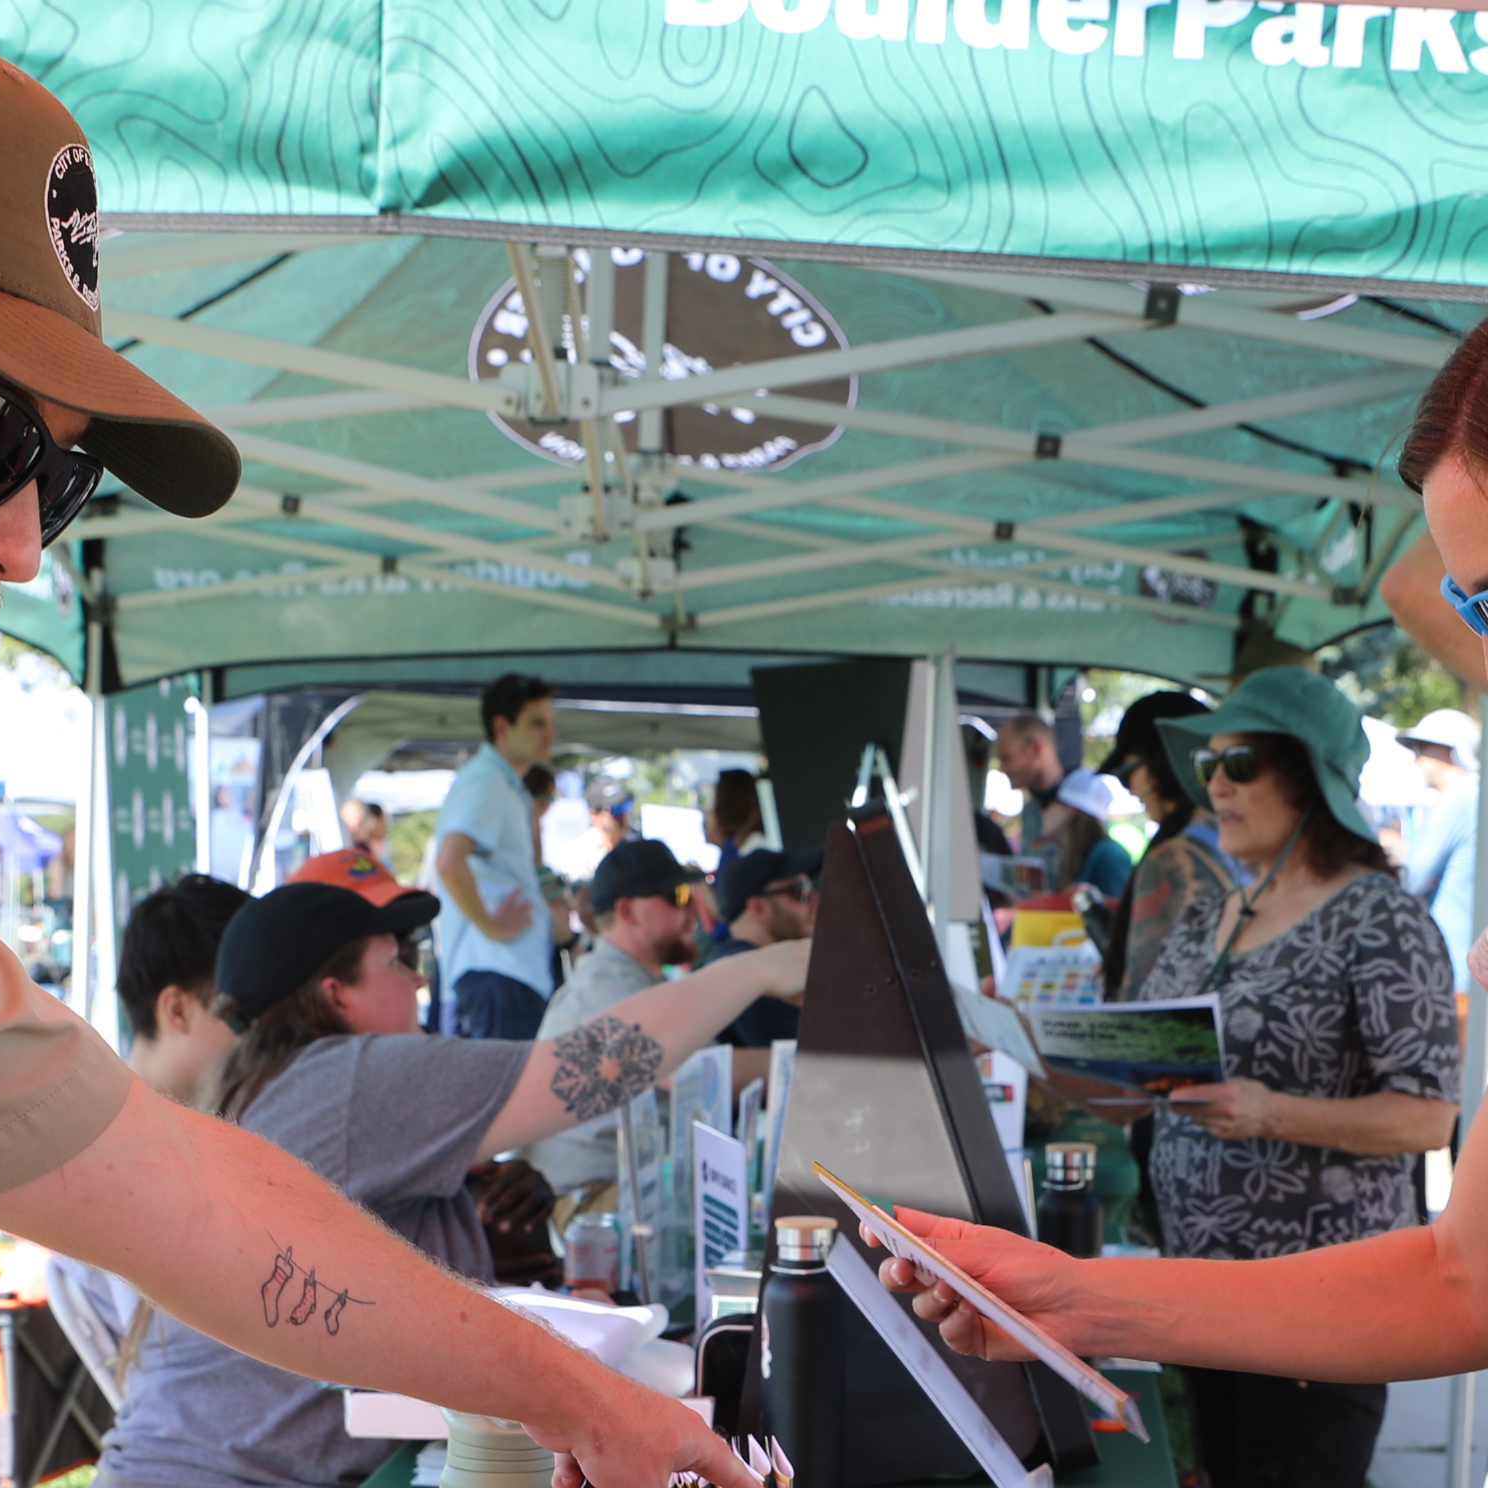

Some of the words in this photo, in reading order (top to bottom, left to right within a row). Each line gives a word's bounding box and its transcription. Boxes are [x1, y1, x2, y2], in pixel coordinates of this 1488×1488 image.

[54, 150, 73, 180] CITY
[72, 148, 85, 164] OF
[50, 216, 74, 279] PARKS
